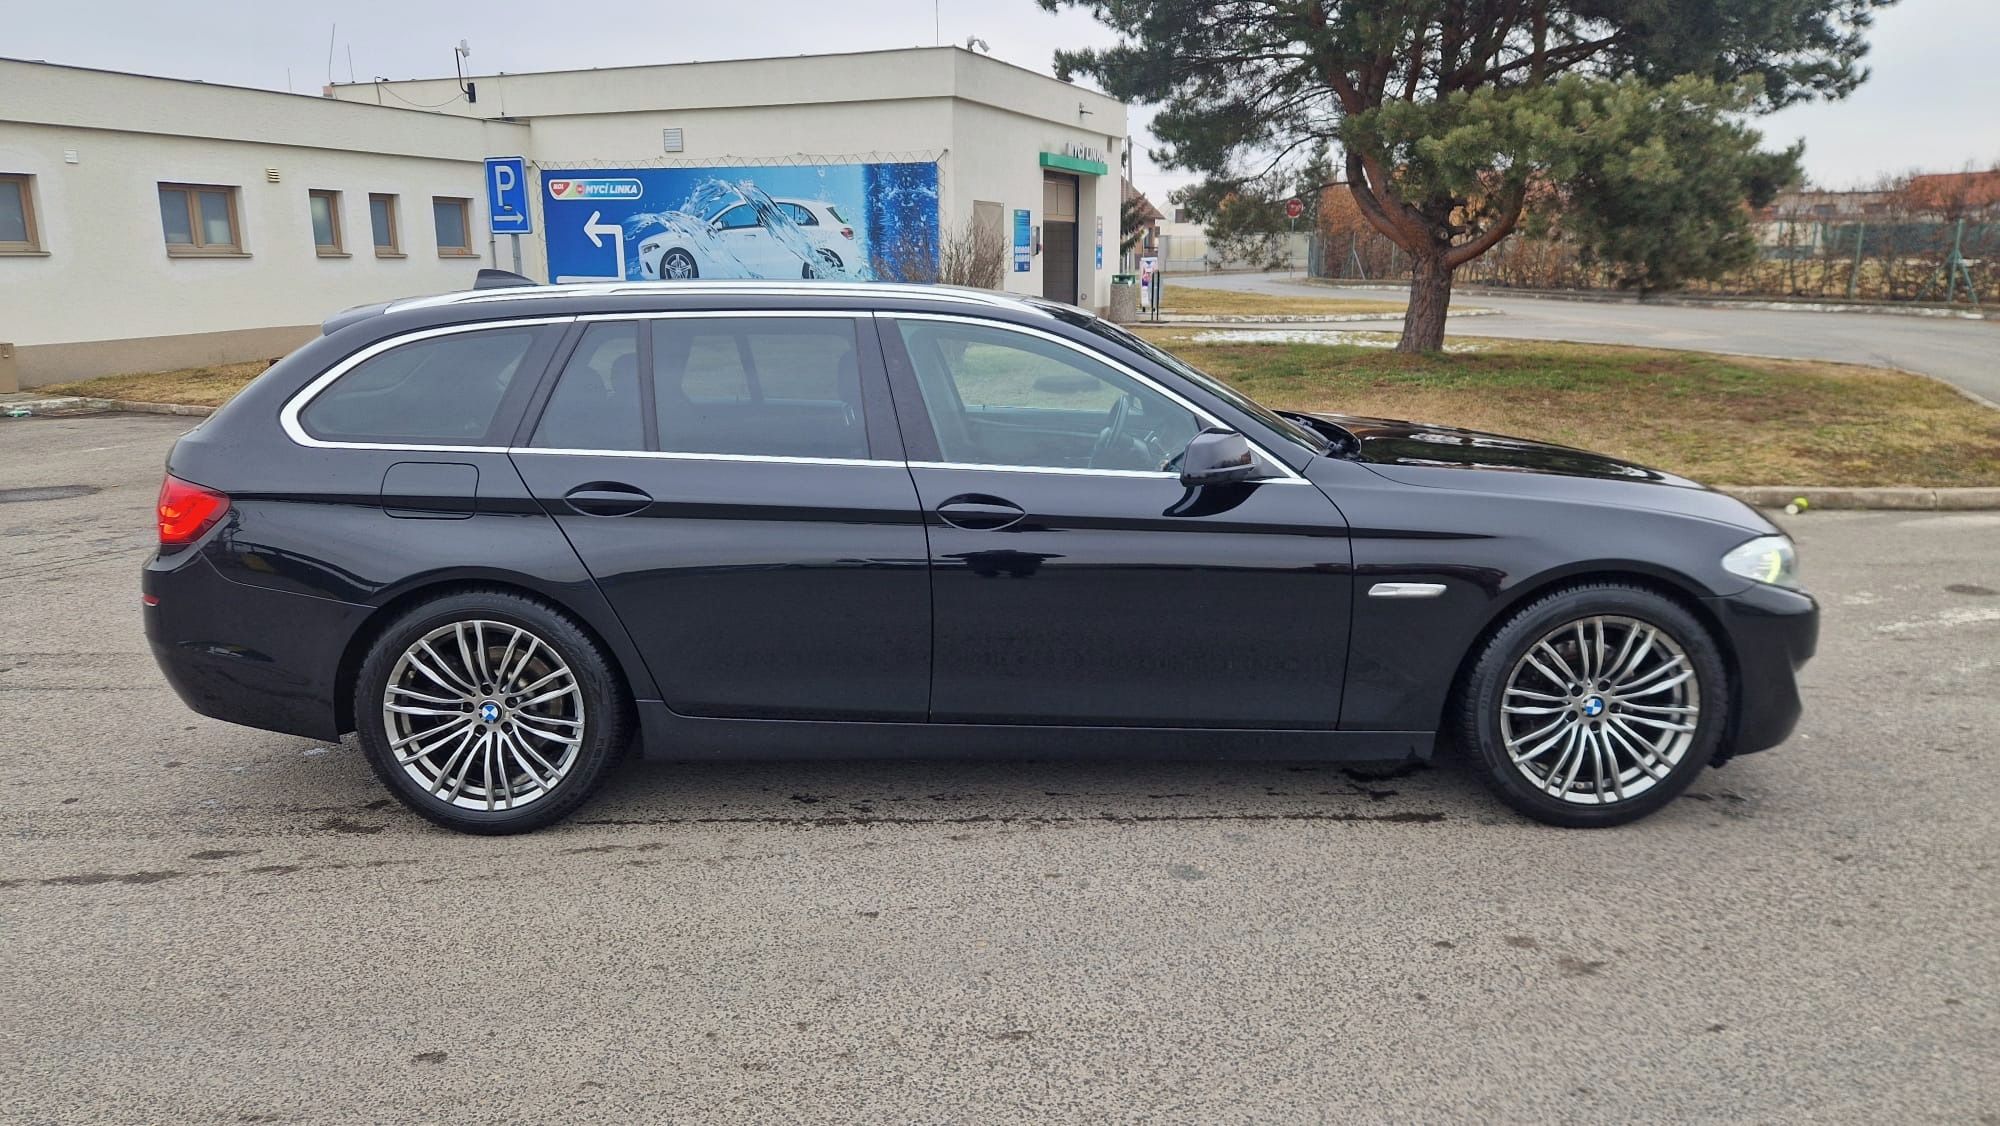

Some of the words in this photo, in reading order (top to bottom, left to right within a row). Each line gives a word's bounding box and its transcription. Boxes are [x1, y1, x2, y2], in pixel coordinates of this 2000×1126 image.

[494, 165, 516, 206] P
[585, 183, 609, 194] MYCÍ
[609, 184, 638, 194] LINKA
